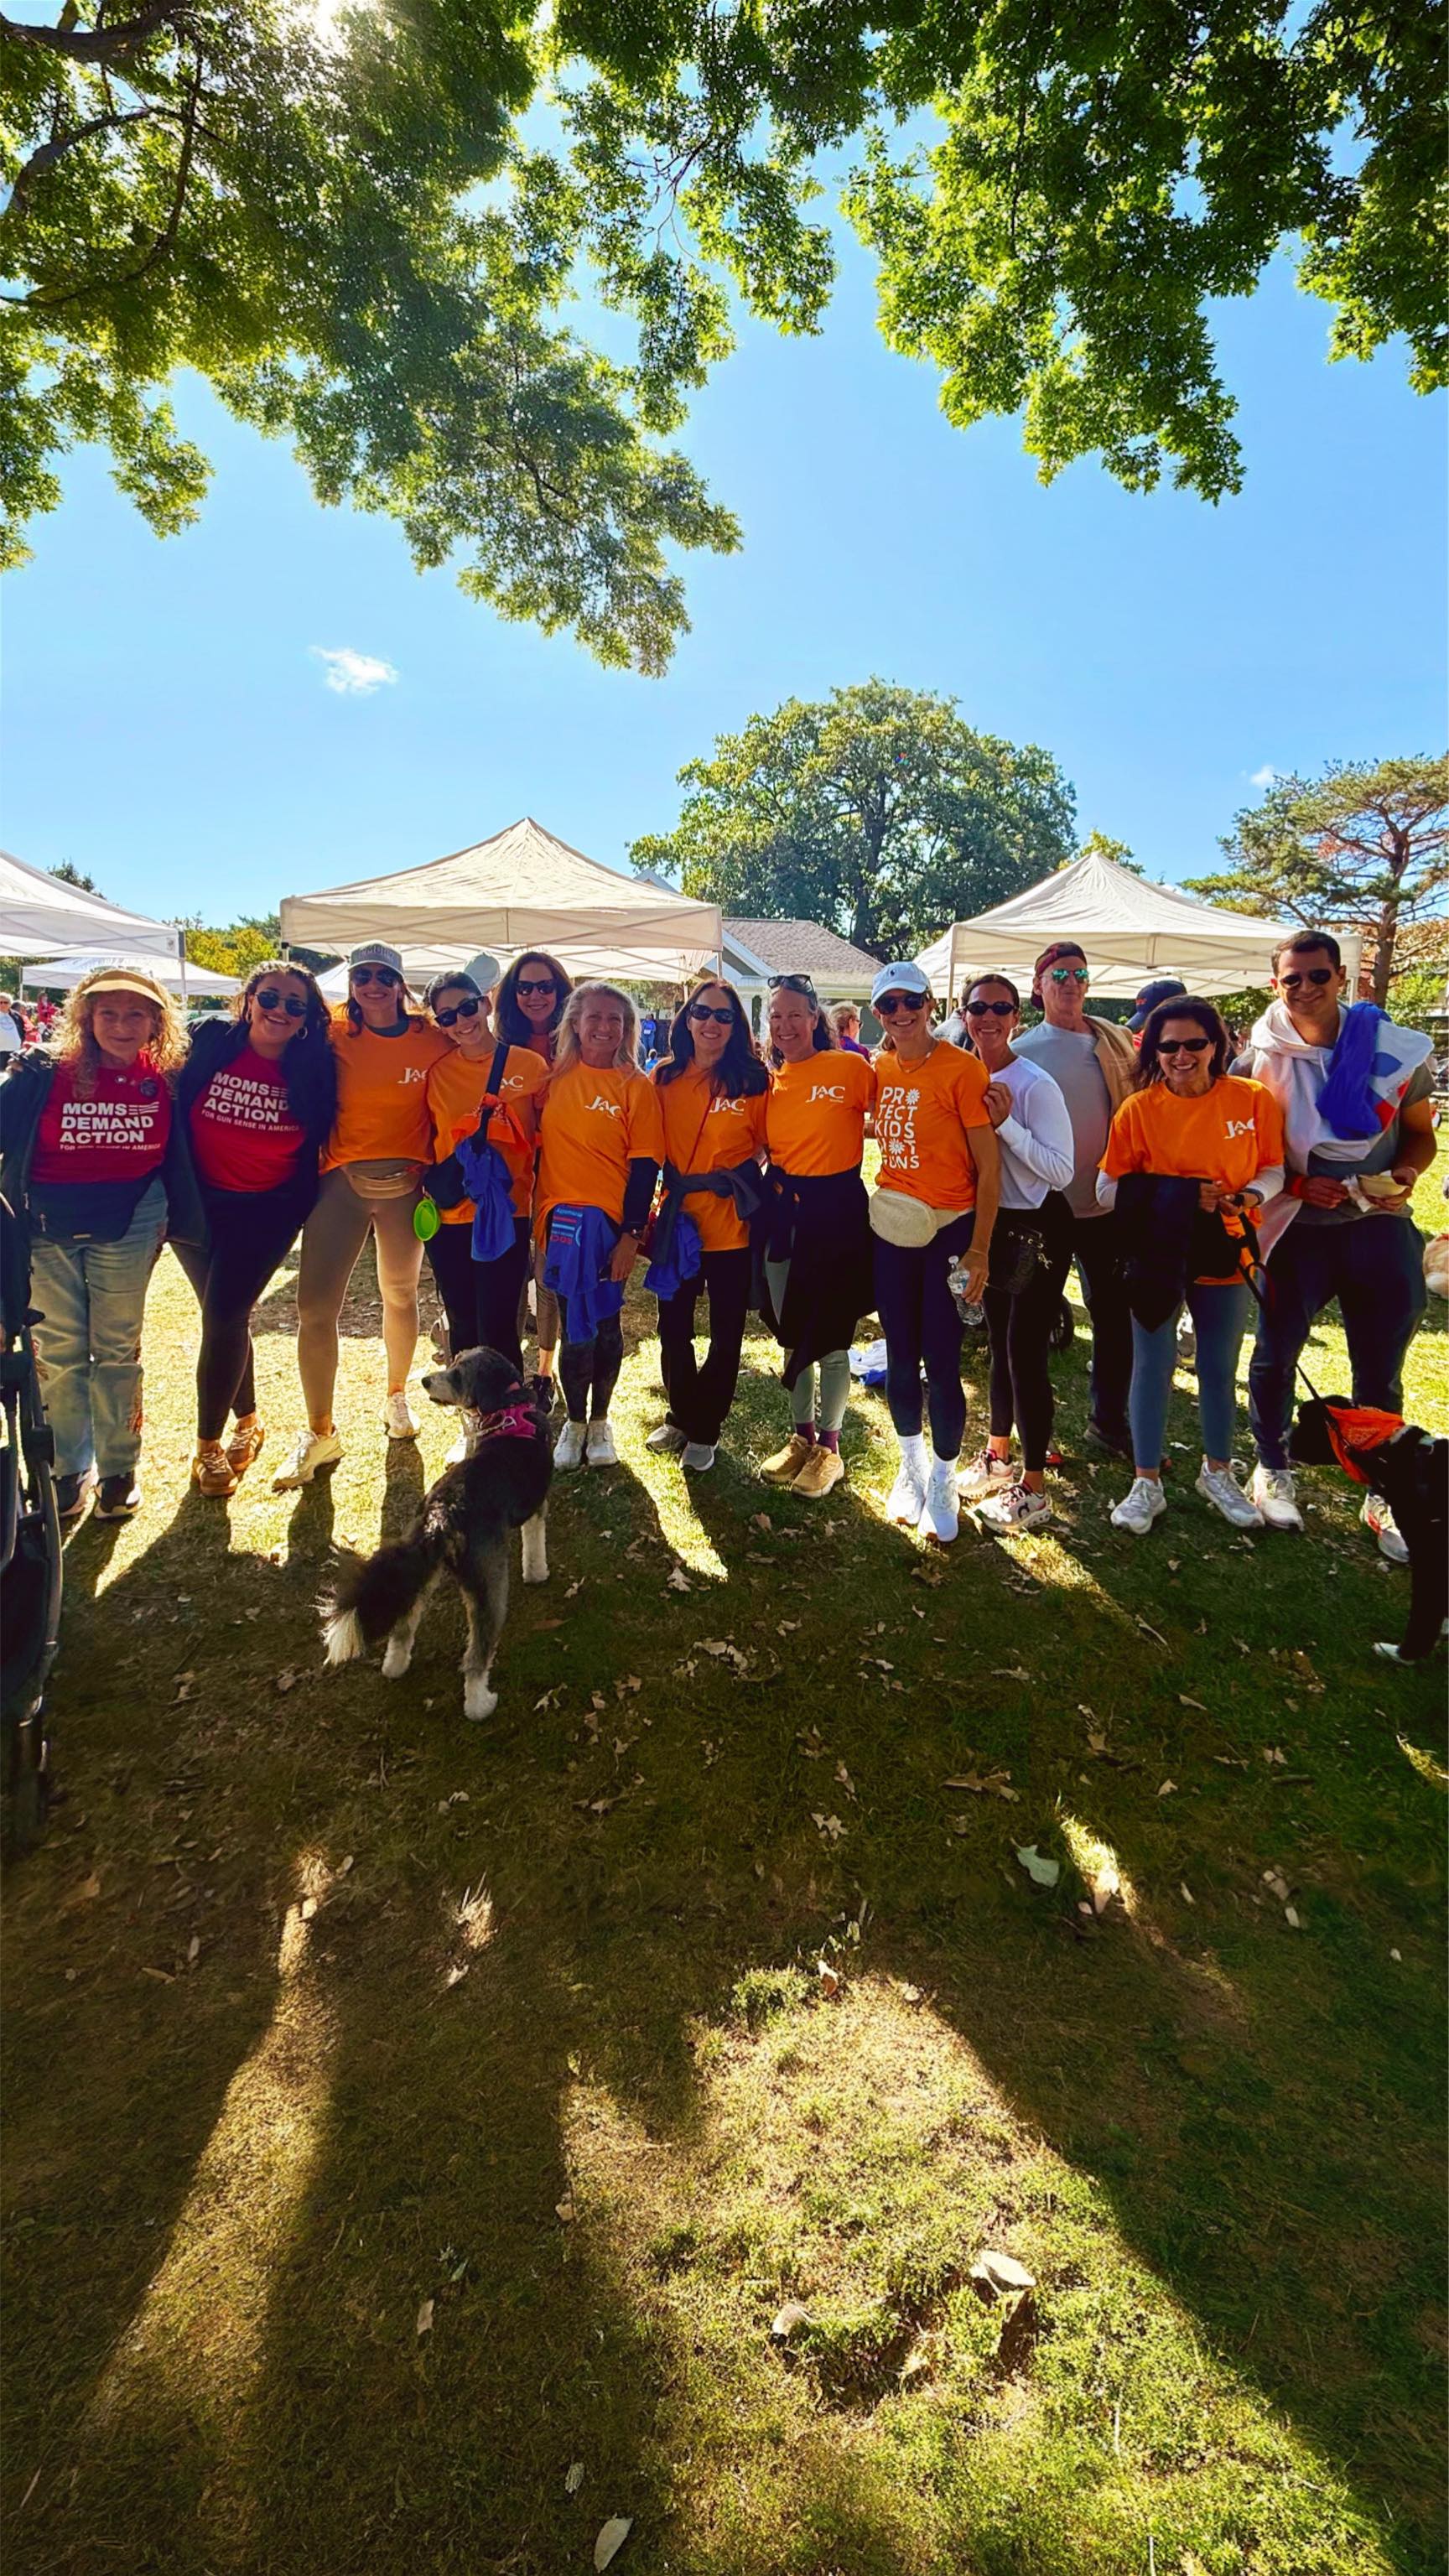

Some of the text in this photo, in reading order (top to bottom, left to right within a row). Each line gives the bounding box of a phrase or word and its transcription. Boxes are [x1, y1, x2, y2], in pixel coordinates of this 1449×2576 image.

[213, 1072, 269, 1095] MOMS
[209, 1084, 288, 1111] DEMAND
[805, 1085, 846, 1104] JAC
[63, 1103, 127, 1116] MOMS
[204, 1098, 278, 1123] ACTION
[709, 1097, 746, 1114] JAC
[878, 1104, 917, 1120] TECT
[61, 1116, 154, 1130] DEMAND
[201, 1109, 215, 1119] FOR
[216, 1115, 231, 1124] GUN
[234, 1119, 257, 1130] SENSE
[875, 1119, 915, 1139] KIDS
[60, 1130, 144, 1144] ACTION
